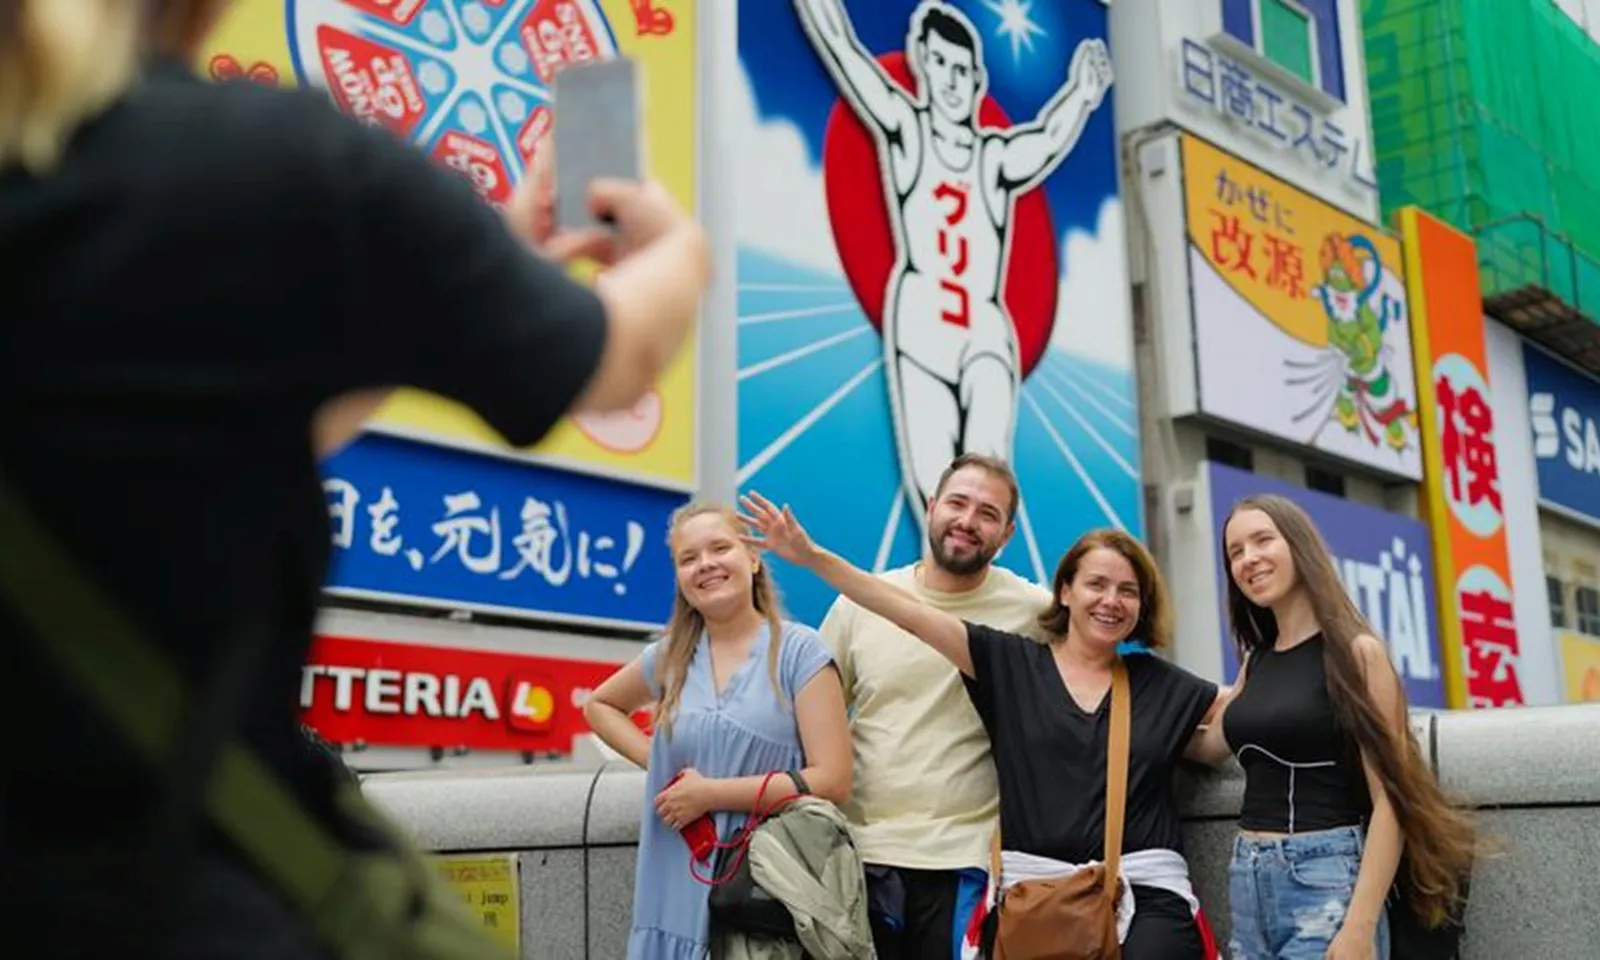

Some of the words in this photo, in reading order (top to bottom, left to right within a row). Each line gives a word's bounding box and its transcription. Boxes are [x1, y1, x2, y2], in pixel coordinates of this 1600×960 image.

[1215, 167, 1295, 235] かぜに
[932, 181, 972, 329] グリコ
[1208, 208, 1308, 299] 改源
[300, 664, 499, 720] TTERIA
